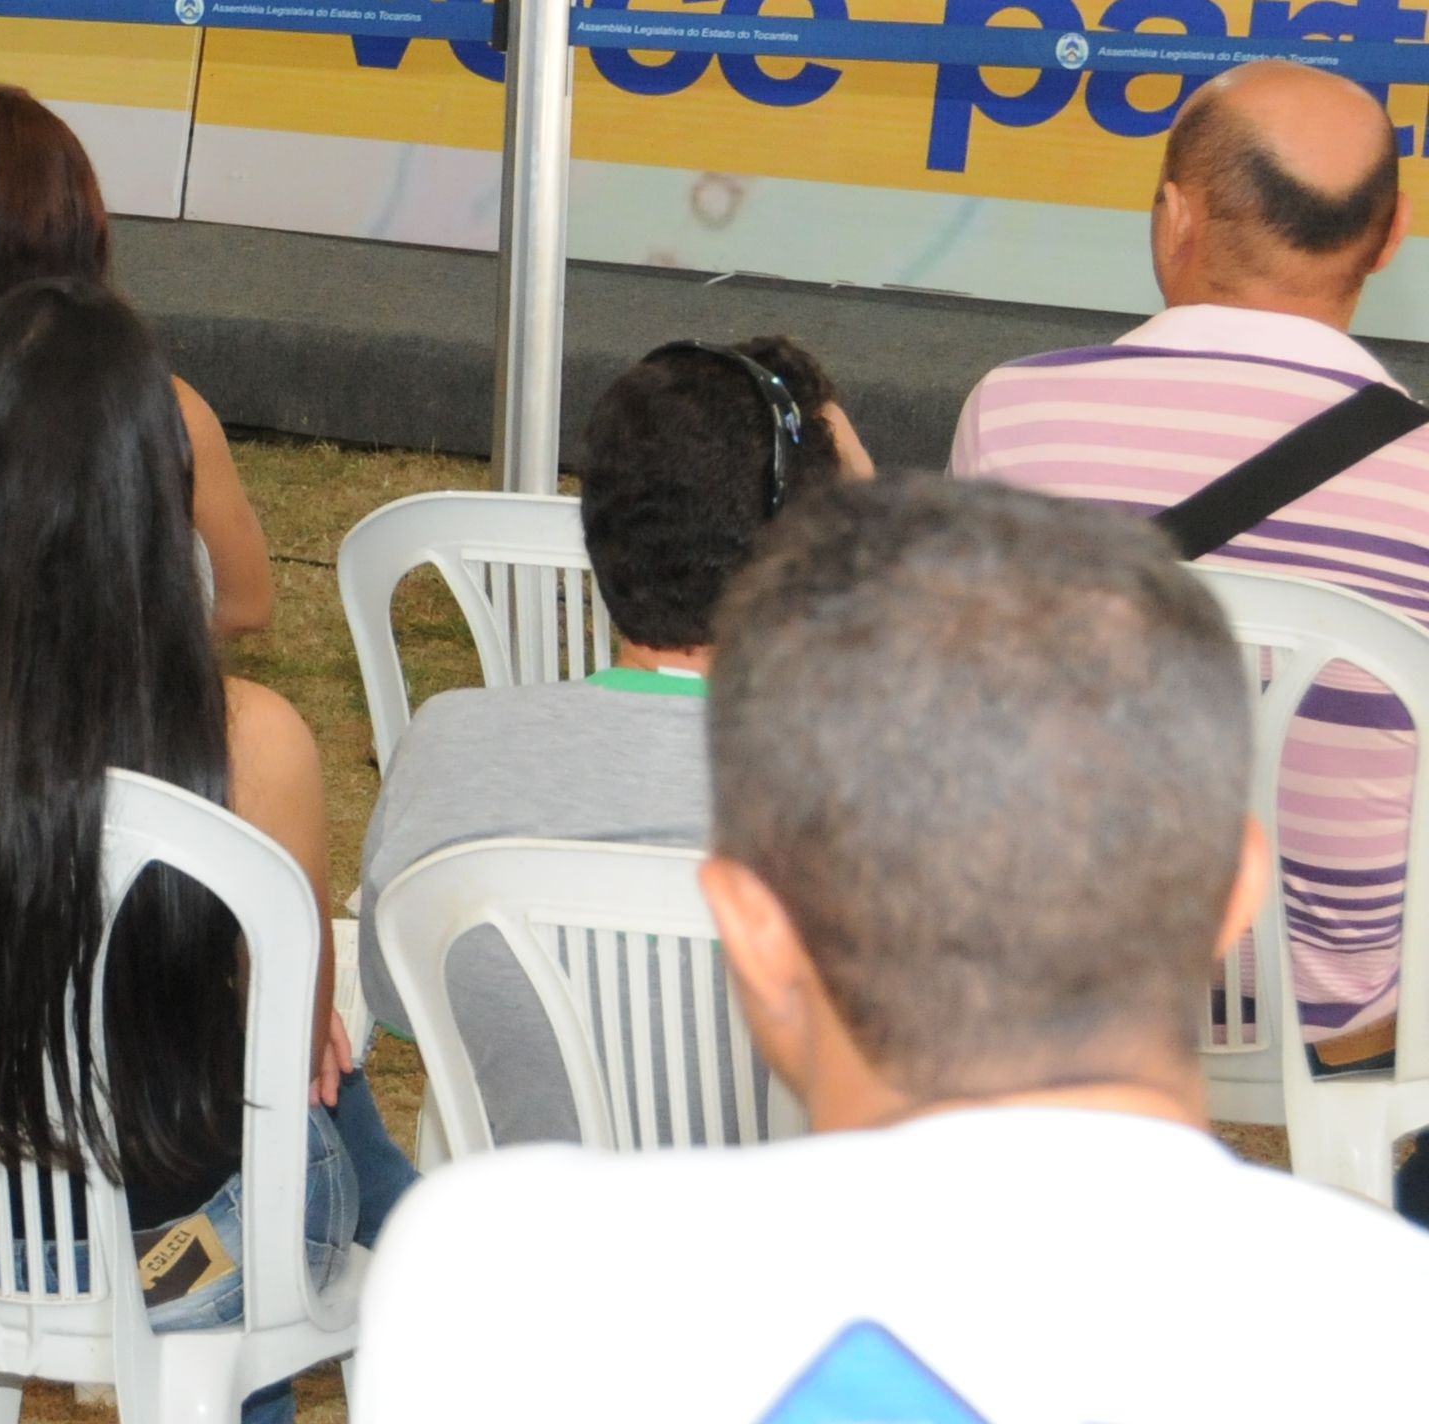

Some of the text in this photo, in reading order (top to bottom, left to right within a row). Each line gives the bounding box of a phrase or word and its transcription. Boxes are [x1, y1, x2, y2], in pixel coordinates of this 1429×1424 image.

[315, 7, 329, 18] do
[329, 8, 363, 20] Estado
[363, 10, 377, 20] do
[378, 10, 422, 22] Tocantins
[687, 26, 700, 38] do
[701, 28, 736, 40] Estado
[737, 29, 751, 40] do
[753, 30, 799, 42] Tocantins
[1159, 49, 1215, 62] Legislativa
[1217, 51, 1231, 62] do
